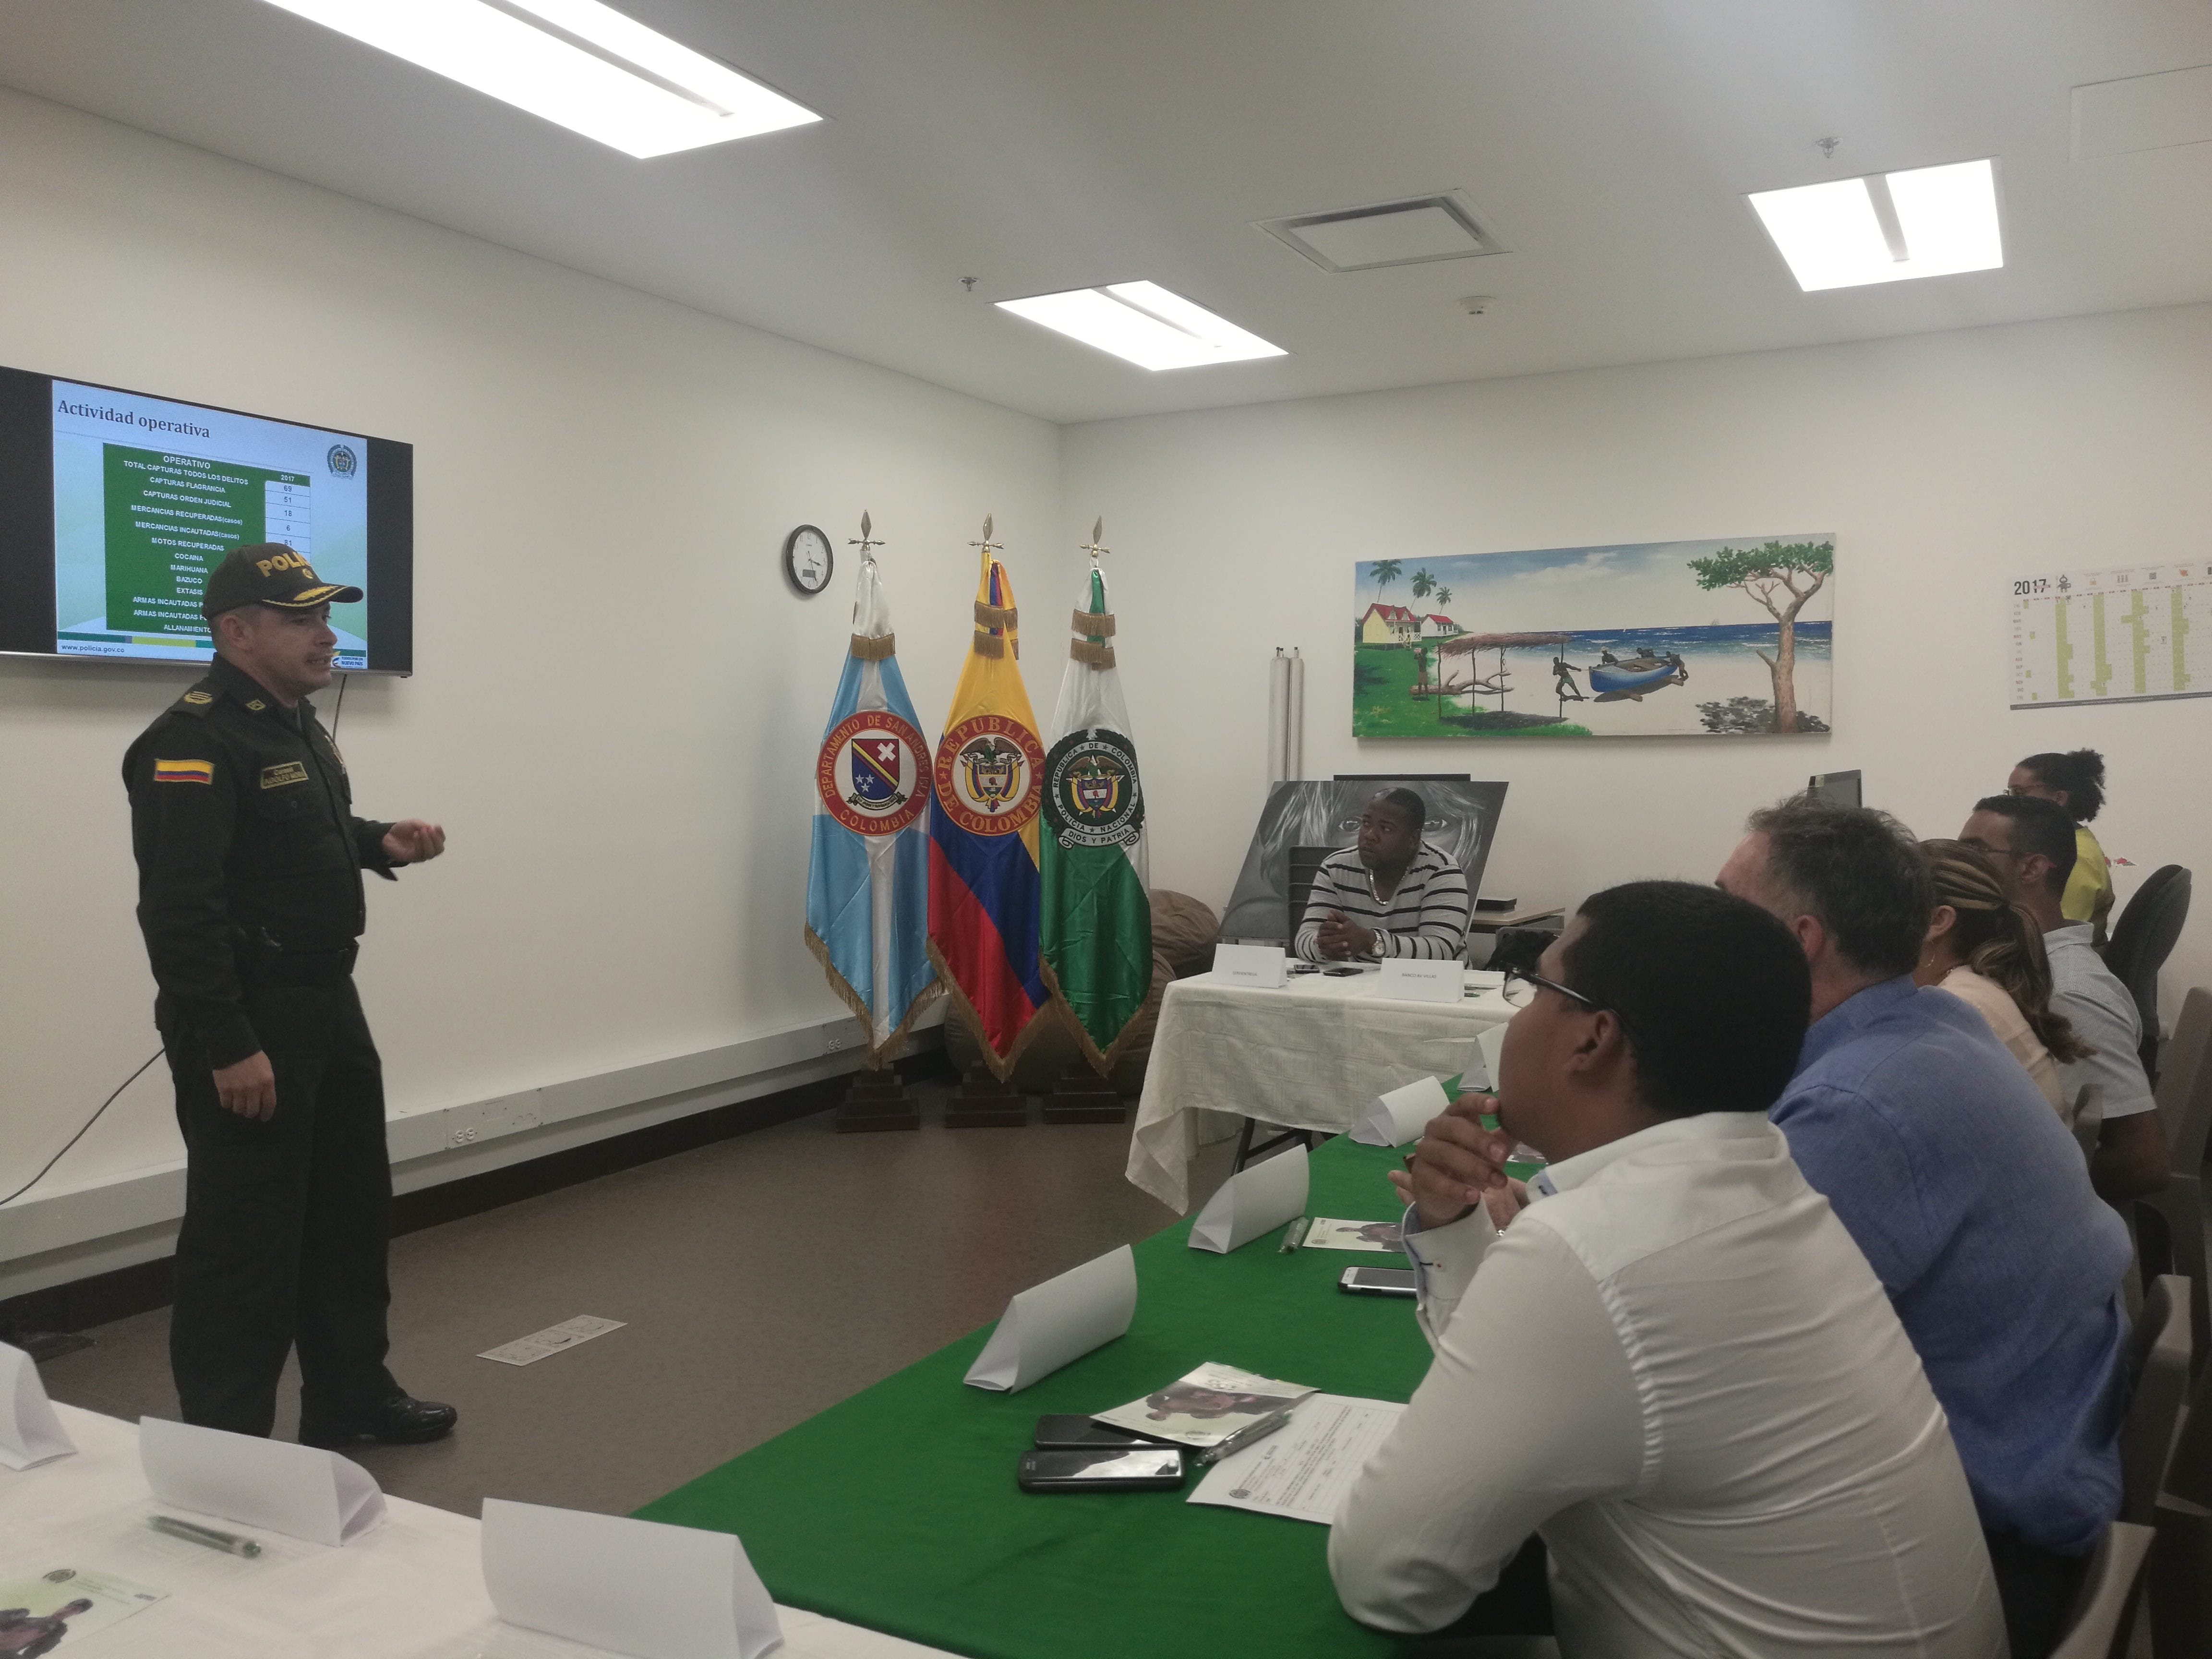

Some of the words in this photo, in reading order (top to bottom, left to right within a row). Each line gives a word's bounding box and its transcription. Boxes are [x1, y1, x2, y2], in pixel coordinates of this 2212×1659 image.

[58, 400, 134, 425] Actividad
[138, 416, 211, 438] operativa
[163, 456, 211, 469] OPERATIVO
[123, 461, 146, 469] TOTAL
[147, 465, 182, 475] CAPTURAS
[183, 470, 206, 479] TODOS
[222, 476, 249, 485] DELITOS
[280, 474, 295, 482] 2017
[150, 477, 185, 487] CAPTURAS
[186, 482, 226, 493] FLAGRANCIA
[143, 490, 179, 500] CAPTURAS
[204, 499, 232, 508] JUDICIAL
[131, 505, 174, 516] MERCANCIAS
[175, 511, 242, 526] RECUPERADAS(casos)
[135, 521, 178, 532] MERCANCIAS
[180, 527, 240, 541] INCAUTADAS(casos)
[152, 537, 177, 546] MOTOS
[178, 541, 225, 552] RECUPERADAS
[174, 553, 204, 562] COCAINA
[170, 564, 208, 574] MARIHUANA
[176, 576, 203, 584] BAZUCO
[2014, 579, 2047, 595] 2017
[176, 587, 204, 595] EXTASIS
[157, 599, 198, 608] INCAUTADAS
[157, 612, 198, 620] INCAUTADAS
[61, 645, 125, 653] www.policia.gov.co
[867, 714, 881, 727] DE
[885, 717, 908, 735] SAN
[937, 716, 1045, 771] REPUBLICA
[821, 719, 860, 799] DEPARTAMENTO
[905, 733, 929, 773] ANDRES
[1053, 749, 1078, 788] REPUBLICA
[1111, 747, 1138, 784] COLOMBIA
[915, 776, 929, 798] ISLA
[938, 781, 960, 812] DE
[959, 784, 1043, 833] COLOMBIA
[840, 808, 914, 832] COLOMBIA
[1058, 804, 1085, 831] POLICIA
[1100, 803, 1136, 833] NACIONAL
[1068, 830, 1087, 843] DIOS
[1101, 828, 1130, 843] PATRIA
